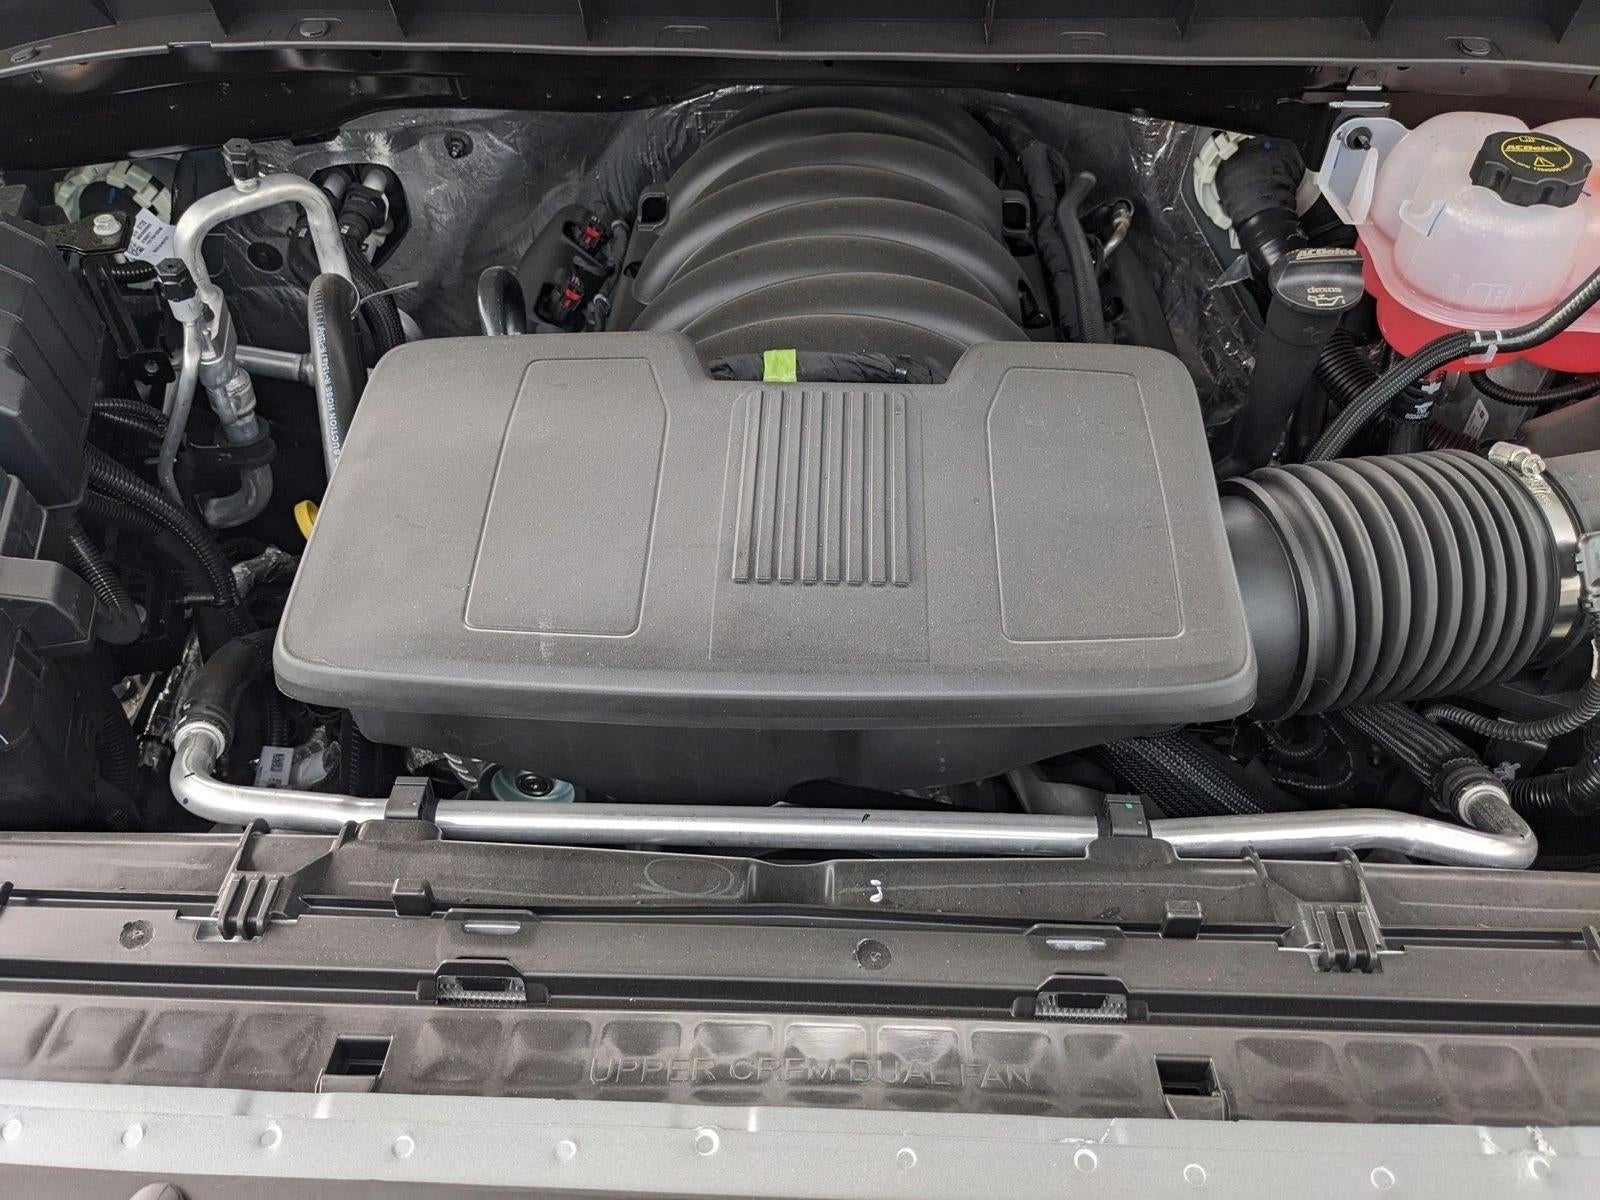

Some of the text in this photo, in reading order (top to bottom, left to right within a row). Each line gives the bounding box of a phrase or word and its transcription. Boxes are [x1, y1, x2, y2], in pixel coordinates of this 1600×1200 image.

[1504, 144, 1562, 153] ACDelco
[1296, 247, 1358, 260] ACDelco
[1307, 286, 1343, 294] dexos
[326, 386, 336, 411] HOSE
[329, 412, 341, 455] SUCTION
[589, 1057, 717, 1085] UPPER
[850, 1059, 951, 1087] DUAL
[960, 1061, 1033, 1091] FAN
